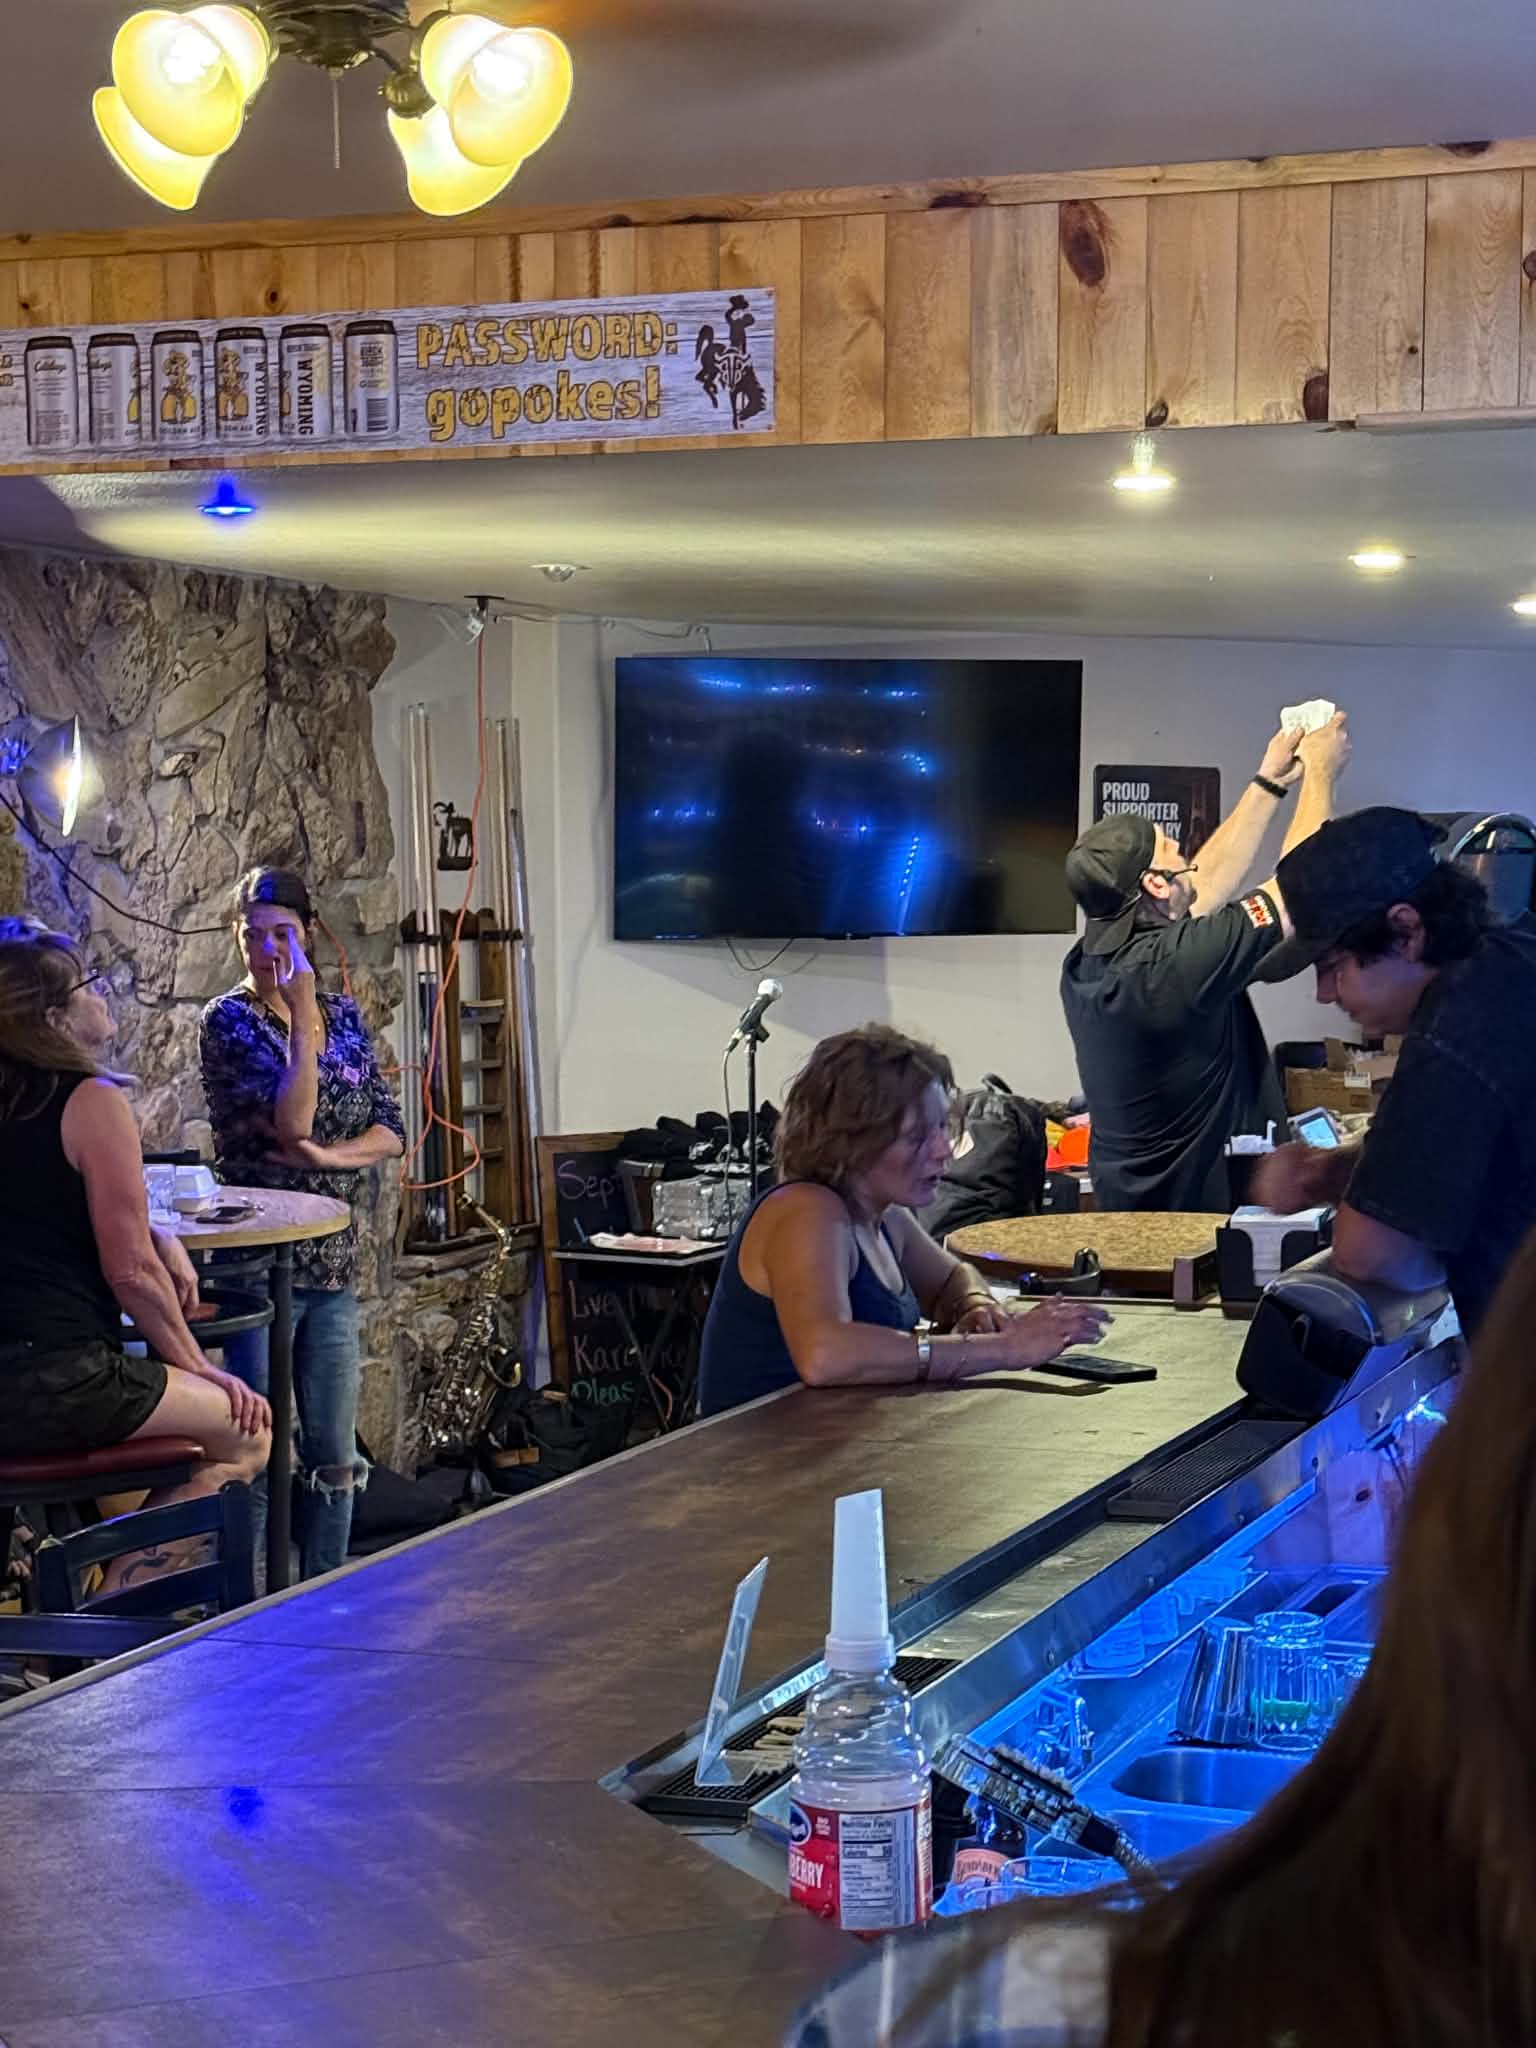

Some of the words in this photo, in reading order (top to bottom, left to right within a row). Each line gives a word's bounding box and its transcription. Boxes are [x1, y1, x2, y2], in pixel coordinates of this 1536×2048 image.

[415, 311, 679, 370] PASSWORD:
[297, 357, 314, 436] WYOMING
[425, 364, 662, 443] gopokes!
[1102, 781, 1151, 801] PROUD
[1102, 801, 1179, 821] SUPPORTER
